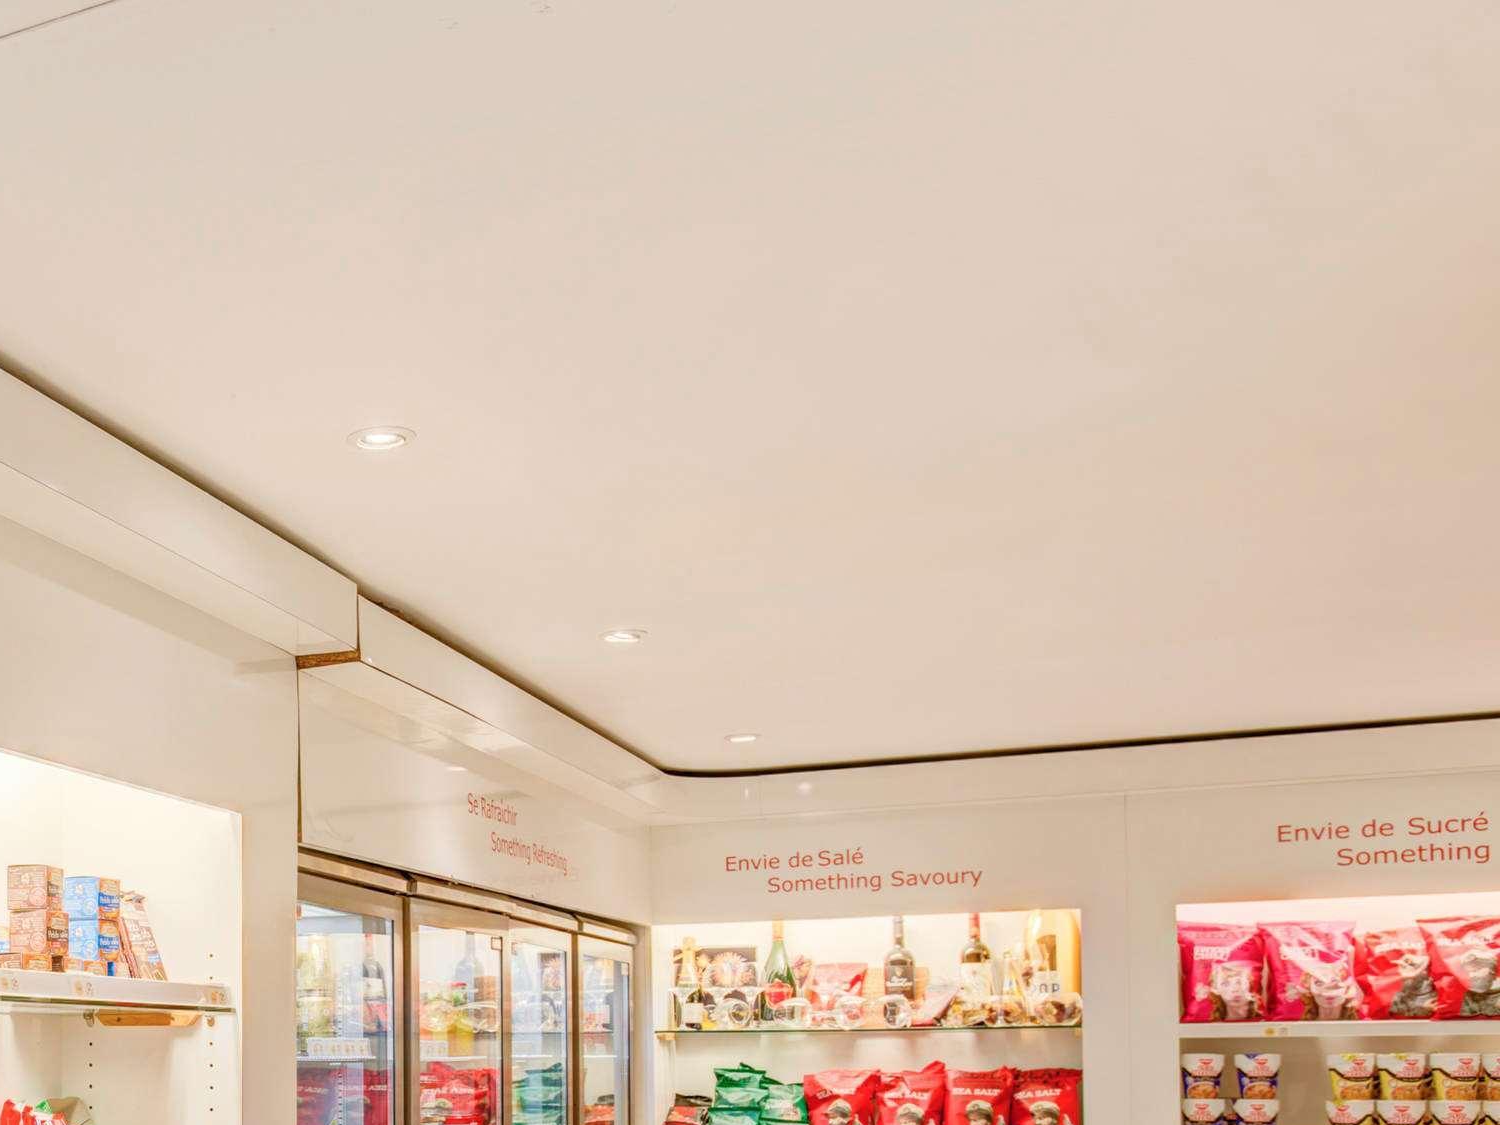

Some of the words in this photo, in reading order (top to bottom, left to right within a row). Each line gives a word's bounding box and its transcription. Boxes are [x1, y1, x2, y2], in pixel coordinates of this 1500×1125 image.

[467, 792, 479, 816] Se
[1277, 822, 1350, 843] Envie
[1361, 820, 1394, 839] de
[1407, 811, 1489, 836] Sucré
[491, 831, 531, 865] Something
[532, 843, 568, 877] Refreshing
[725, 853, 780, 872] Envie
[788, 850, 813, 869] de
[818, 847, 864, 868] Salé
[1336, 841, 1491, 867] Something
[767, 871, 881, 895] Something
[891, 868, 983, 889] Savoury
